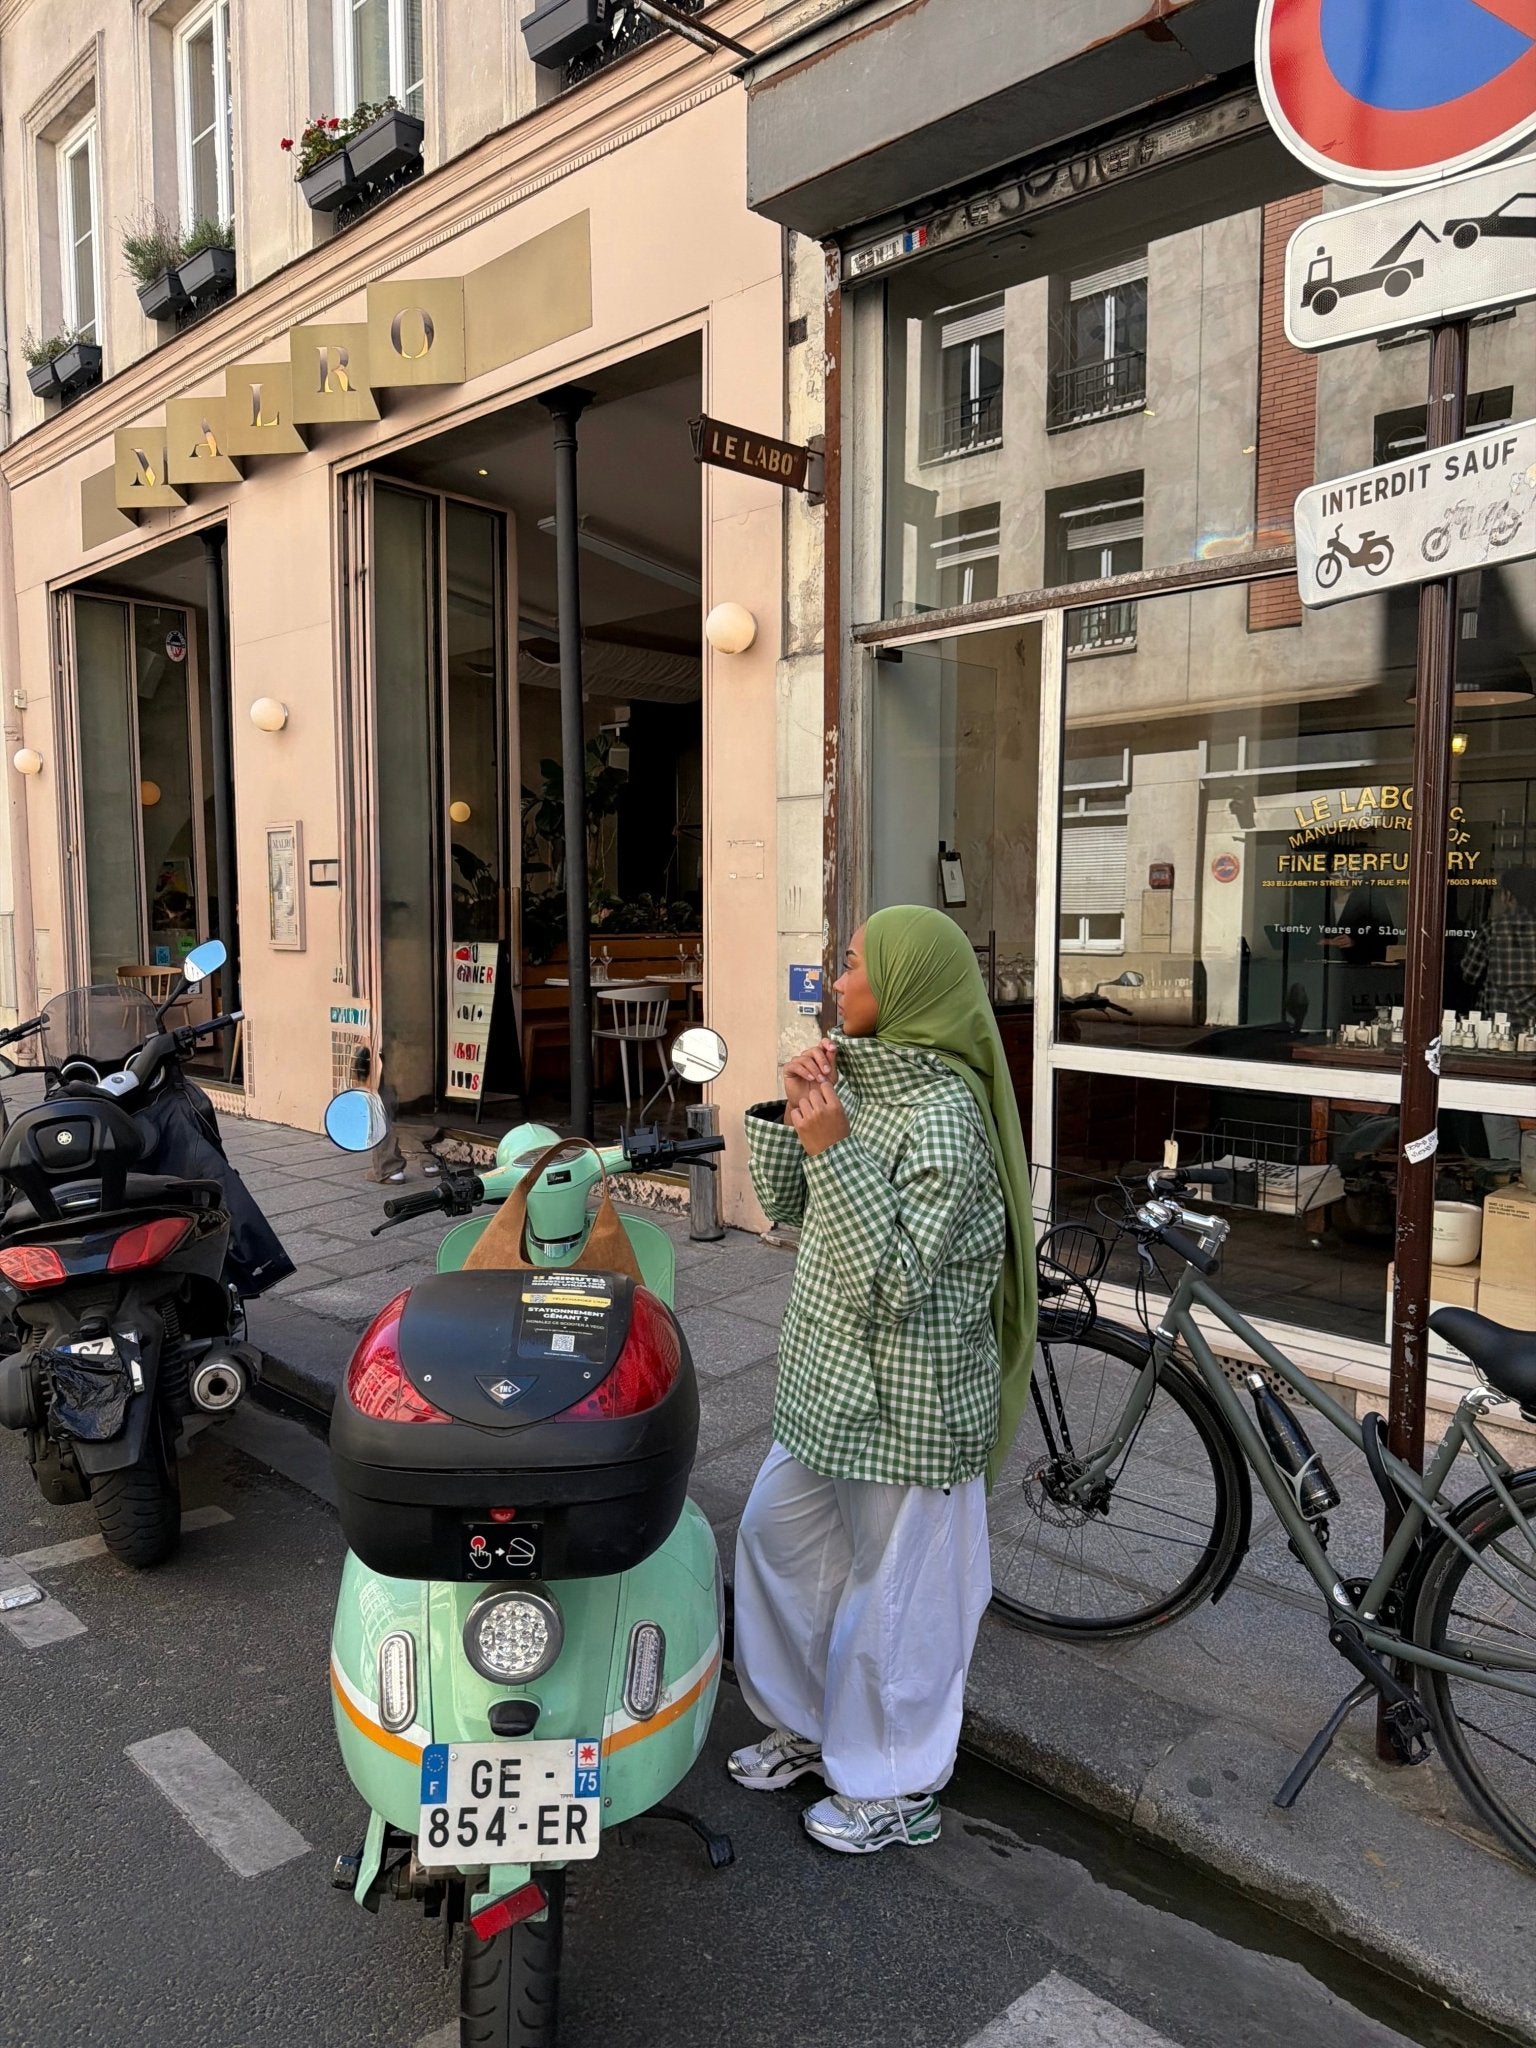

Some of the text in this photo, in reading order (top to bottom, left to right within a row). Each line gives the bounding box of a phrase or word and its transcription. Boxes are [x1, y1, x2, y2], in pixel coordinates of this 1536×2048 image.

[712, 431, 793, 476] LE LABO
[1321, 437, 1518, 517] INTERDIT SAUF
[1294, 796, 1332, 828] LE
[1278, 851, 1481, 873] FINE PERFURY
[1276, 879, 1318, 888] ELIZABETH
[1320, 879, 1349, 887] STREET
[1351, 879, 1363, 887] NY
[1274, 924, 1312, 936] Twenty
[1319, 925, 1351, 935] Years
[1358, 925, 1372, 935] of
[528, 1307, 606, 1318] STATIONNEMENT
[543, 1312, 581, 1321] GÊNANT
[429, 1781, 439, 1796] F
[471, 1759, 521, 1799] GE
[578, 1771, 598, 1792] 75
[428, 1804, 588, 1849] 854-ER
